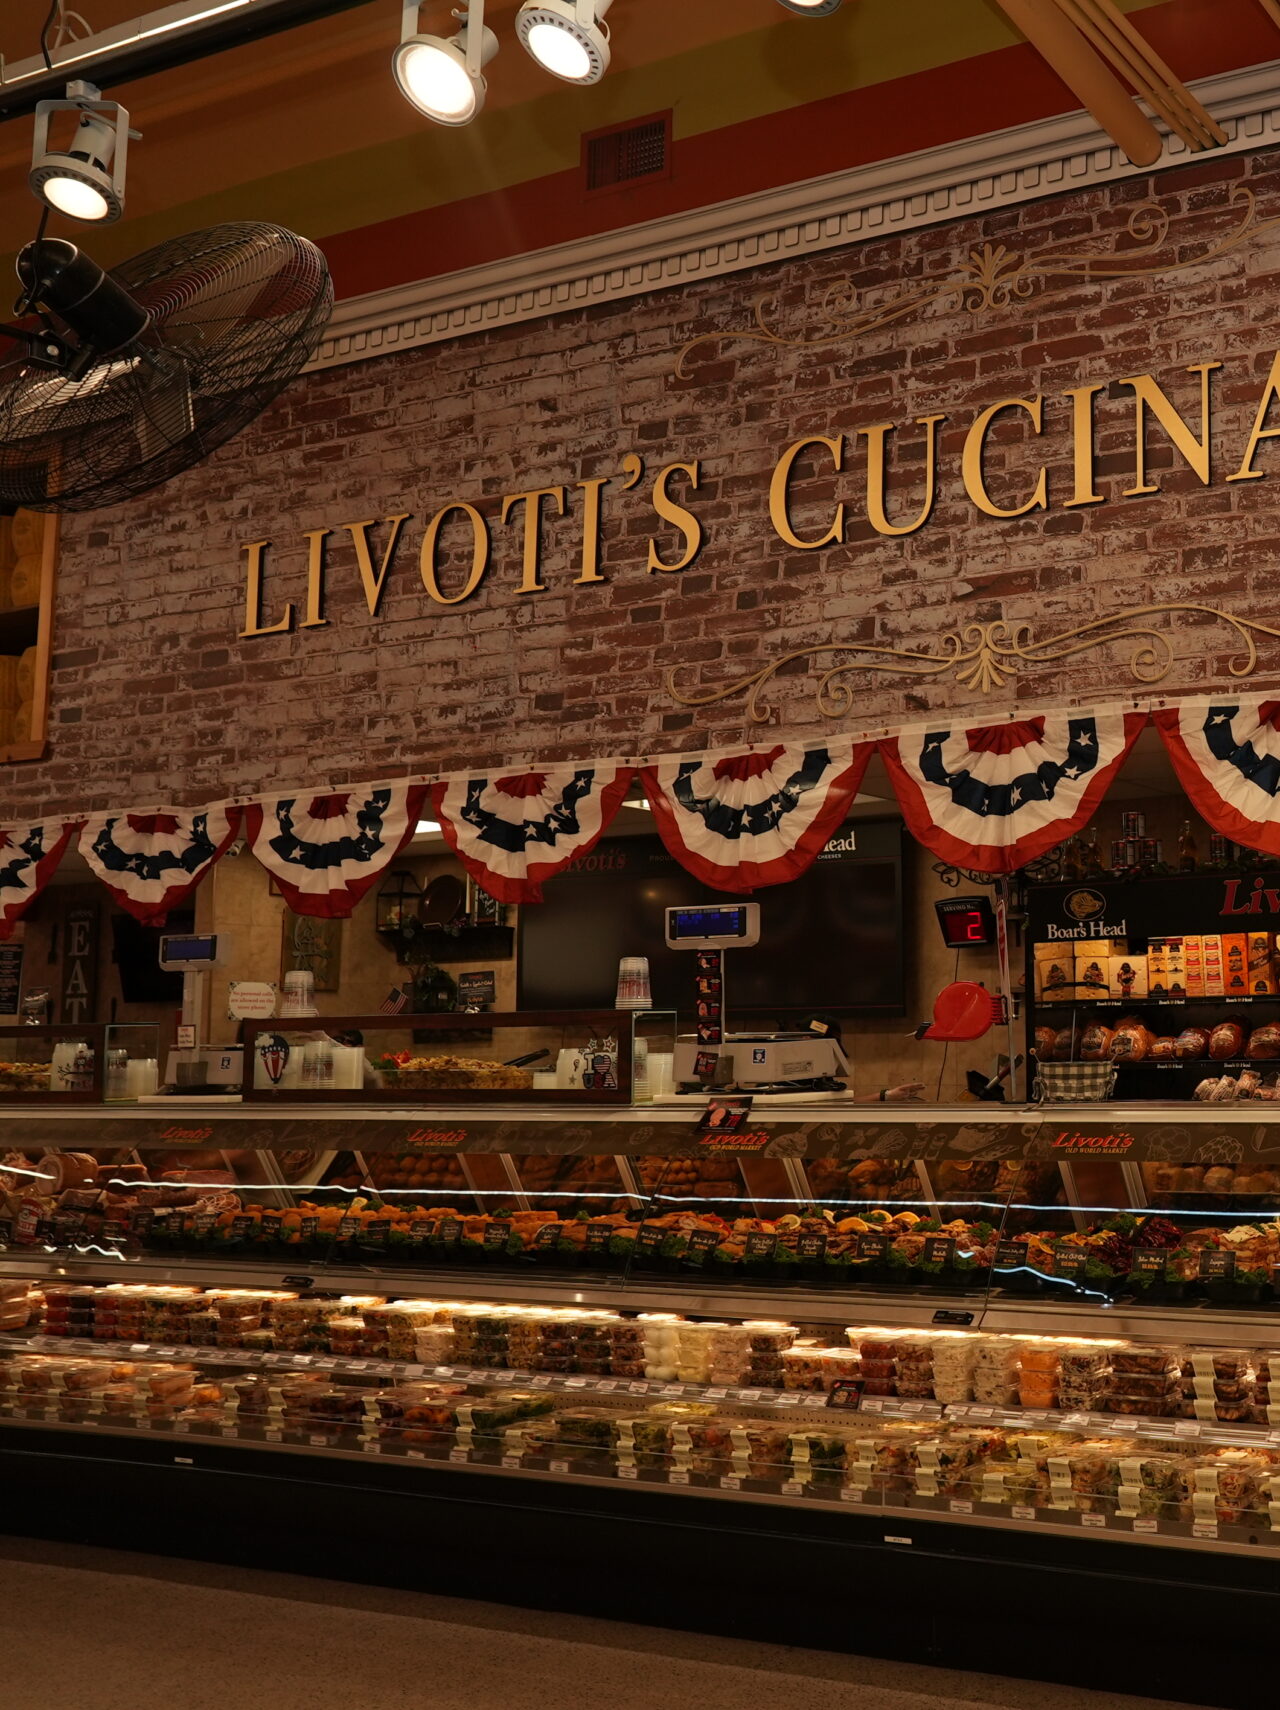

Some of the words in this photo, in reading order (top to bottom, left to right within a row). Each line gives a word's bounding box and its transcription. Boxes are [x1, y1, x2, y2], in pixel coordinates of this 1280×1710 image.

[822, 830, 857, 852] ead
[967, 911, 983, 940] 2
[1089, 918, 1128, 938] Head
[66, 921, 91, 1024] EAT
[1064, 1147, 1079, 1155] OLD
[1079, 1147, 1101, 1155] WORLD
[1102, 1147, 1129, 1155] MARKET
